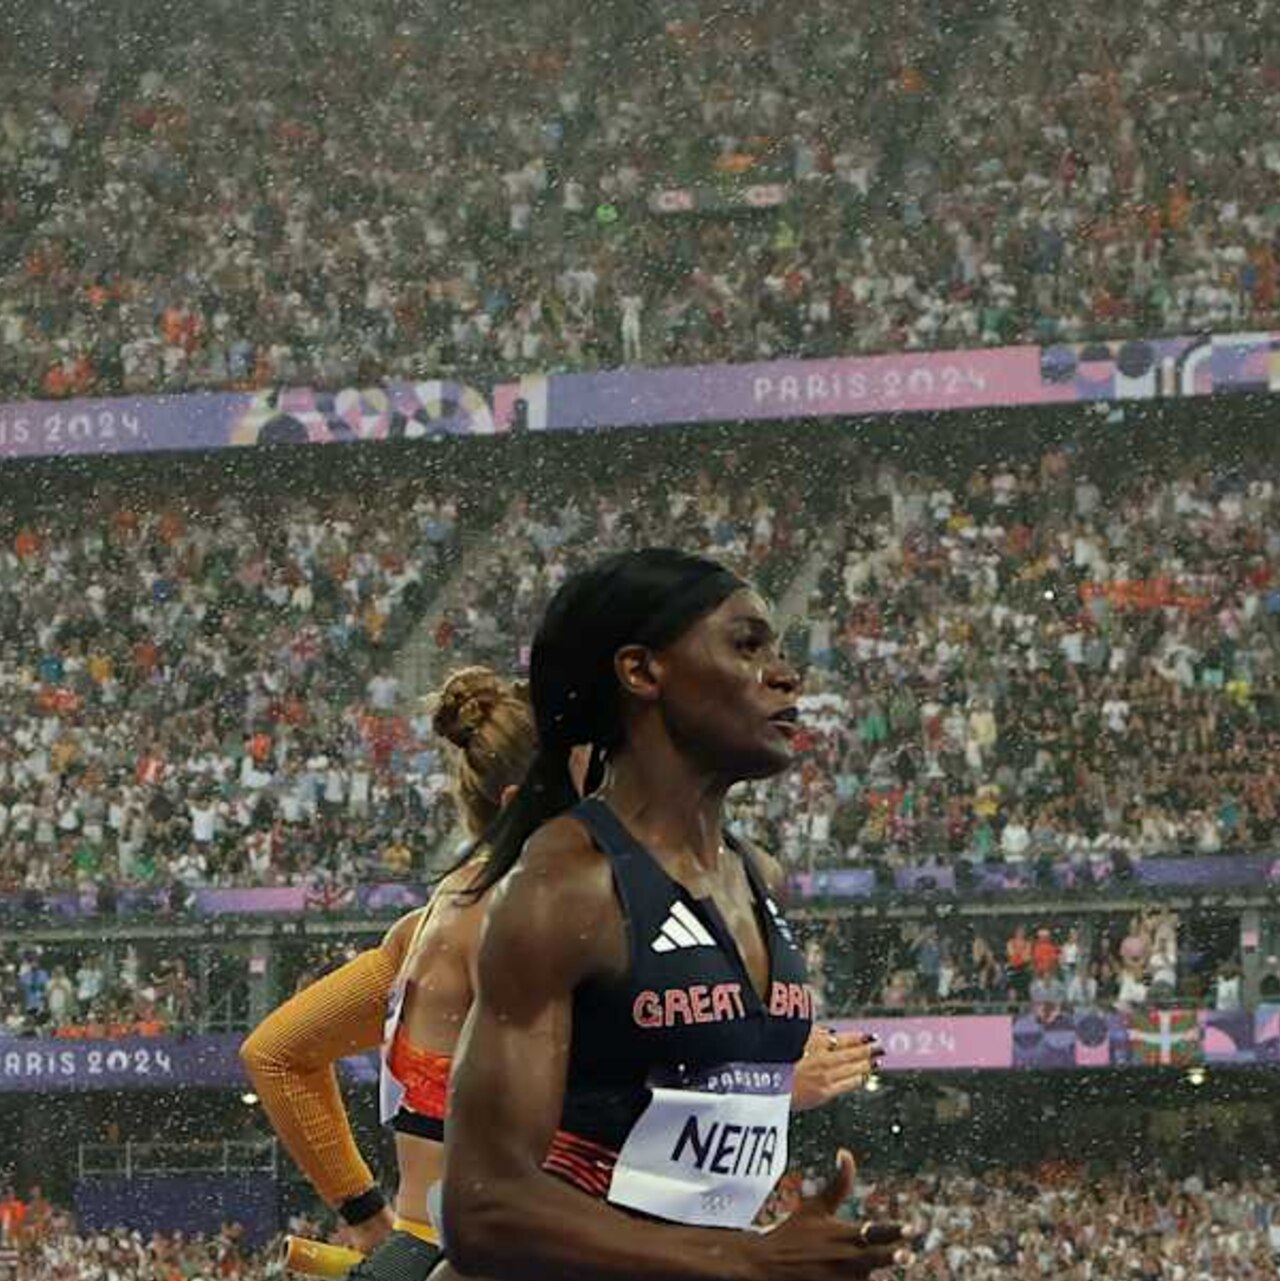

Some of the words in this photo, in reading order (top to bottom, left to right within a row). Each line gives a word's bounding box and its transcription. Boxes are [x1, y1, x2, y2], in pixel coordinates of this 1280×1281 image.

[632, 982, 747, 1028] GREAT
[87, 1049, 171, 1075] 2024
[670, 1115, 777, 1176] NEITA
